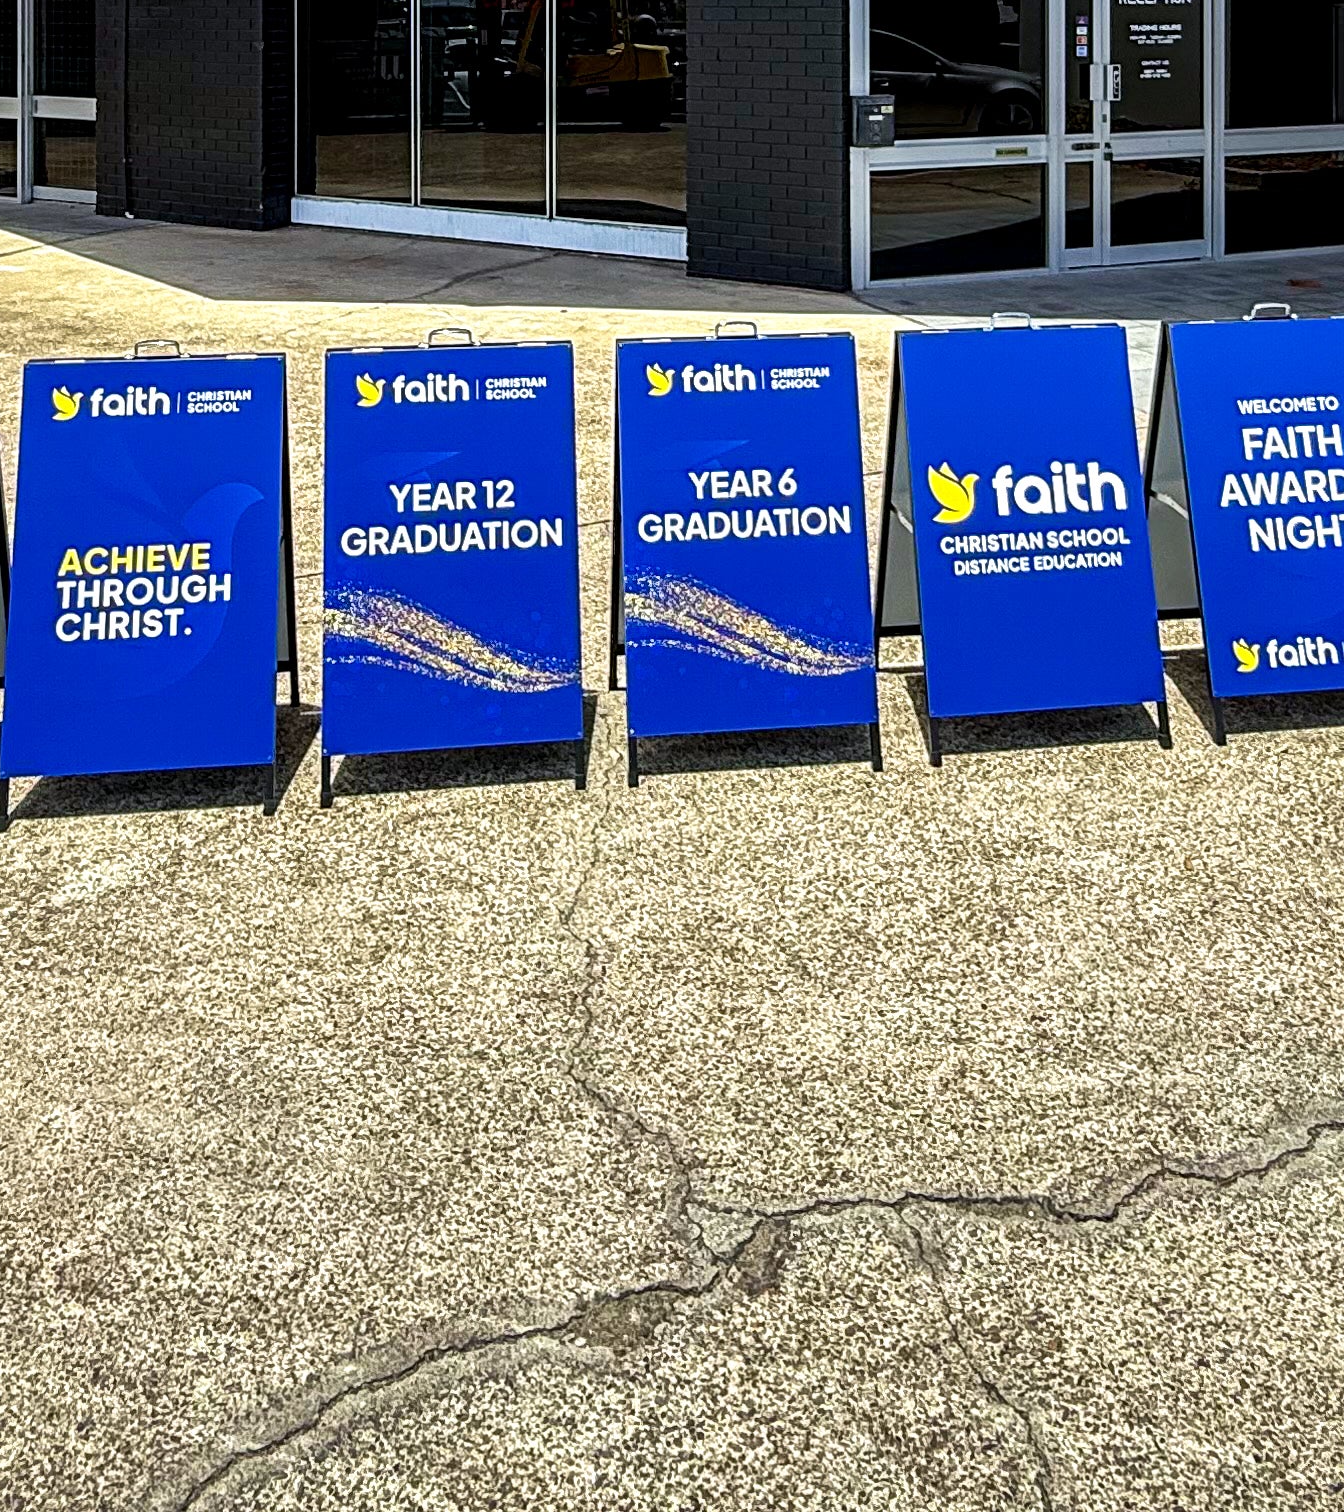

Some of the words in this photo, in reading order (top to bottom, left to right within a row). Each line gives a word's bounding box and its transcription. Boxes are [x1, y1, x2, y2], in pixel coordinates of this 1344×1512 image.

[485, 377, 546, 388] CHRISTIAN
[682, 364, 756, 392] faith
[770, 367, 830, 378] CHRISTIAN
[771, 378, 820, 389] SCHOOL
[90, 386, 170, 417] faith
[188, 390, 251, 402] CHRISTIAN
[393, 373, 469, 403] faith
[486, 388, 536, 400] SCHOOL
[187, 401, 239, 413] SCHOOL
[1237, 397, 1317, 414] WELCOME
[1316, 396, 1339, 410] TO
[1242, 424, 1343, 460] FAITH
[390, 482, 476, 512] YEAR
[482, 480, 515, 509] 12
[688, 470, 773, 499] YEAR
[778, 469, 797, 496] 6
[992, 461, 1127, 516] faith
[341, 518, 562, 556] GRADUATION
[638, 506, 851, 542] GRADUATION
[940, 532, 1043, 554] CHRISTIAN
[1047, 527, 1130, 548] SCHOOL
[58, 543, 210, 576] ACHIEVE
[954, 557, 1030, 575] DISTANCE
[1034, 552, 1122, 570] EDUCATION
[57, 574, 231, 609] THROUGH
[56, 608, 192, 641] CHRIST.
[1267, 637, 1339, 668] faith
